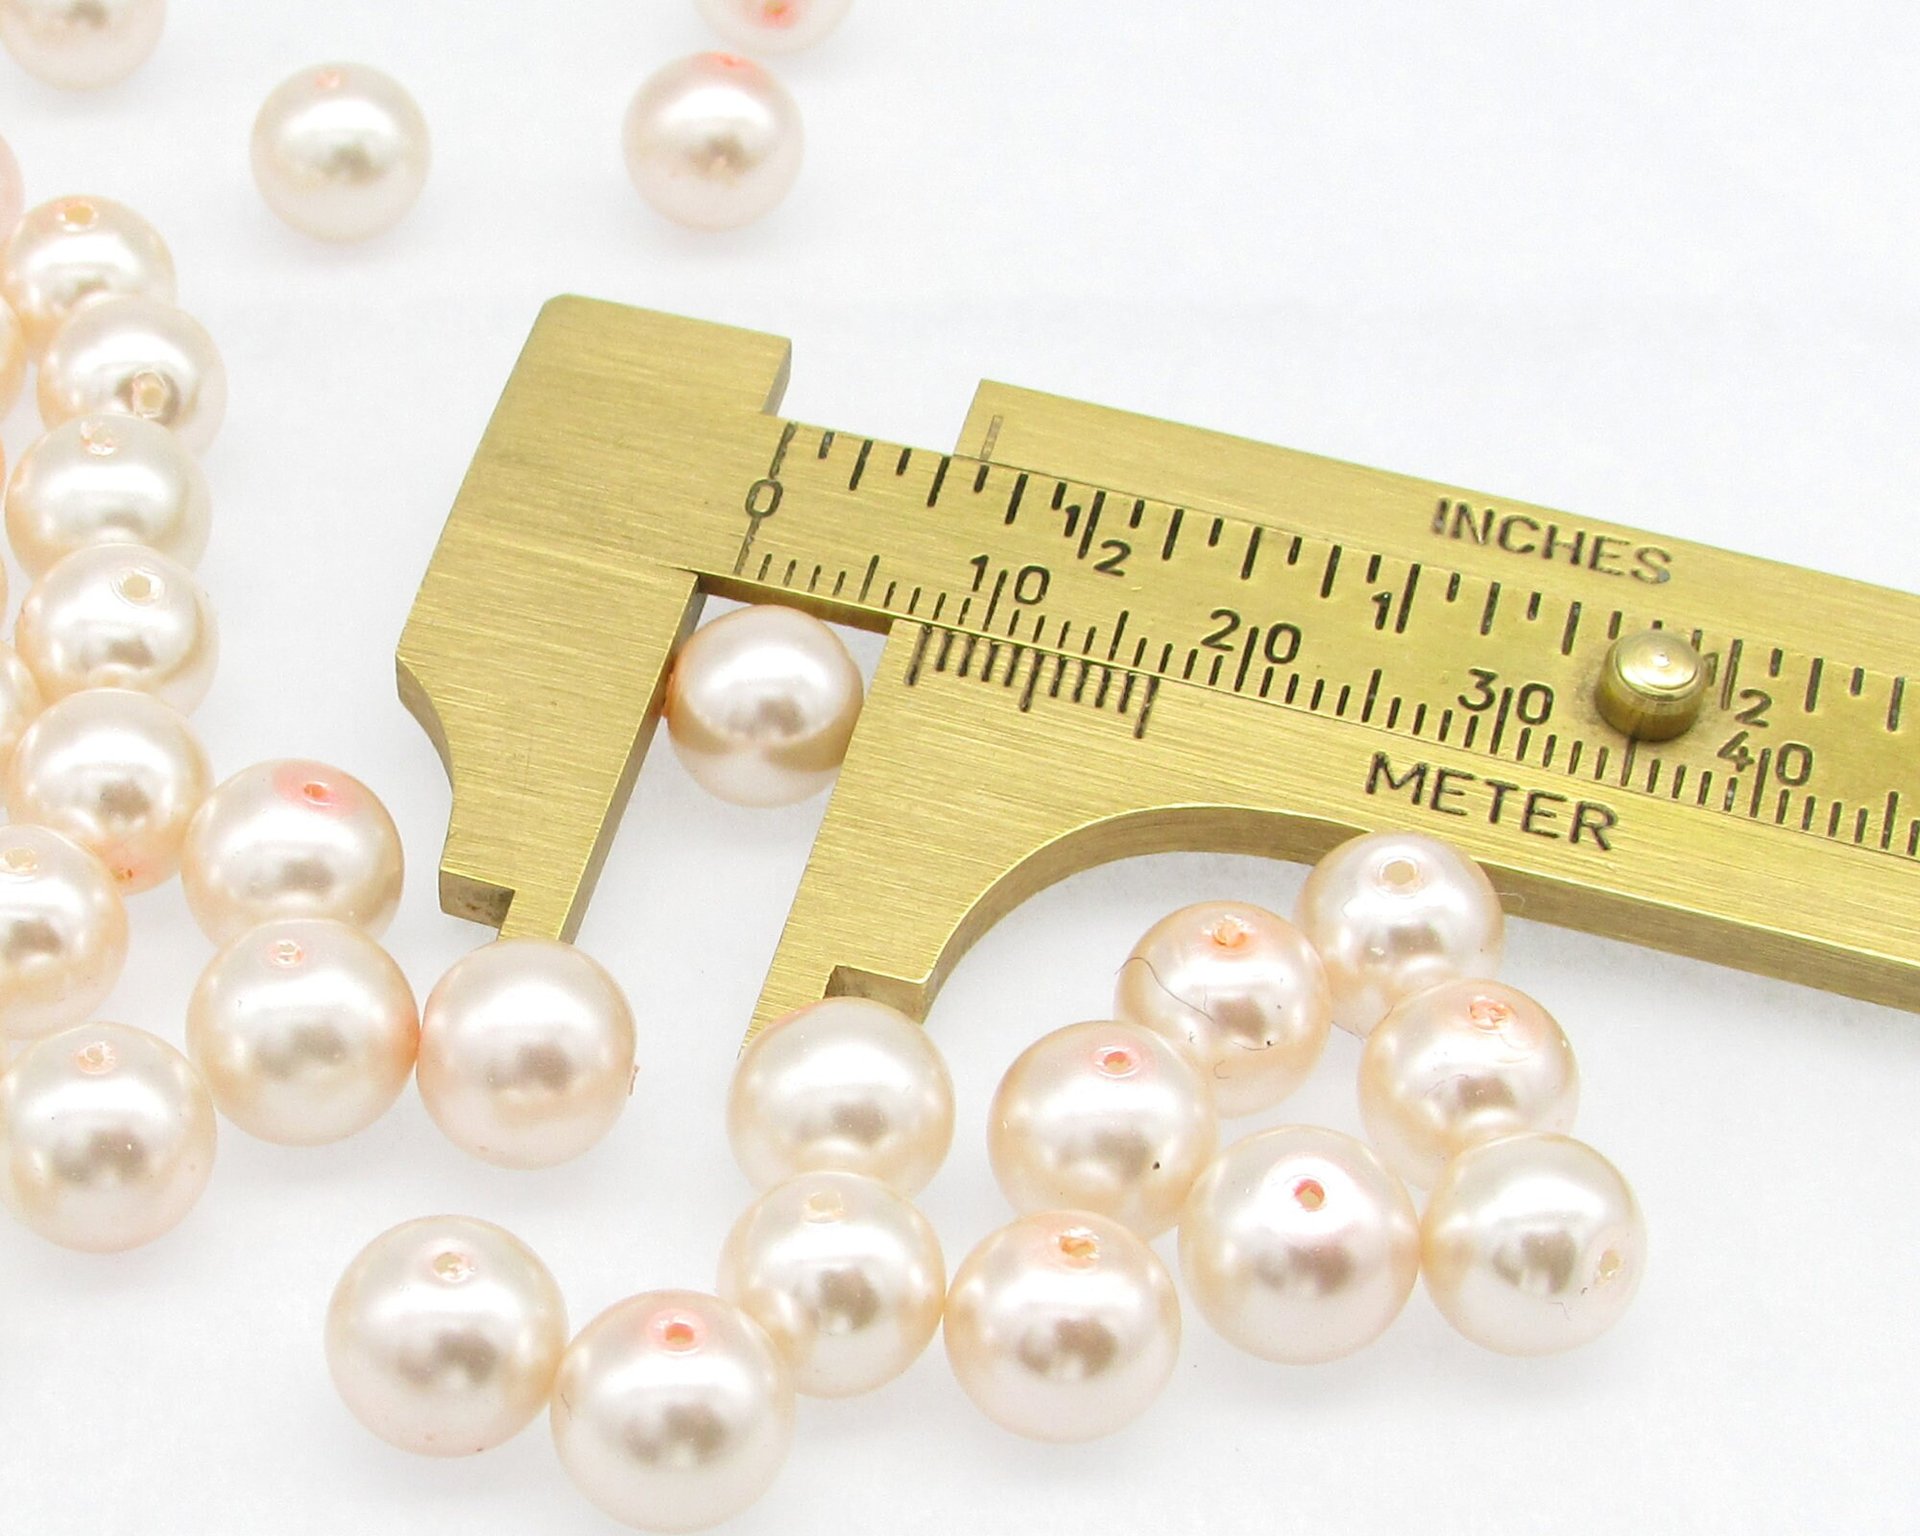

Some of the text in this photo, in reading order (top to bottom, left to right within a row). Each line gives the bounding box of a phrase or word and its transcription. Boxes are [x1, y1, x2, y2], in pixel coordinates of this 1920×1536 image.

[745, 477, 783, 518] 0
[1432, 497, 1672, 584] INCHES
[970, 554, 1050, 605] 10
[1200, 608, 1302, 665] 20
[1457, 667, 1554, 725] 30
[1365, 750, 1618, 851] METER
